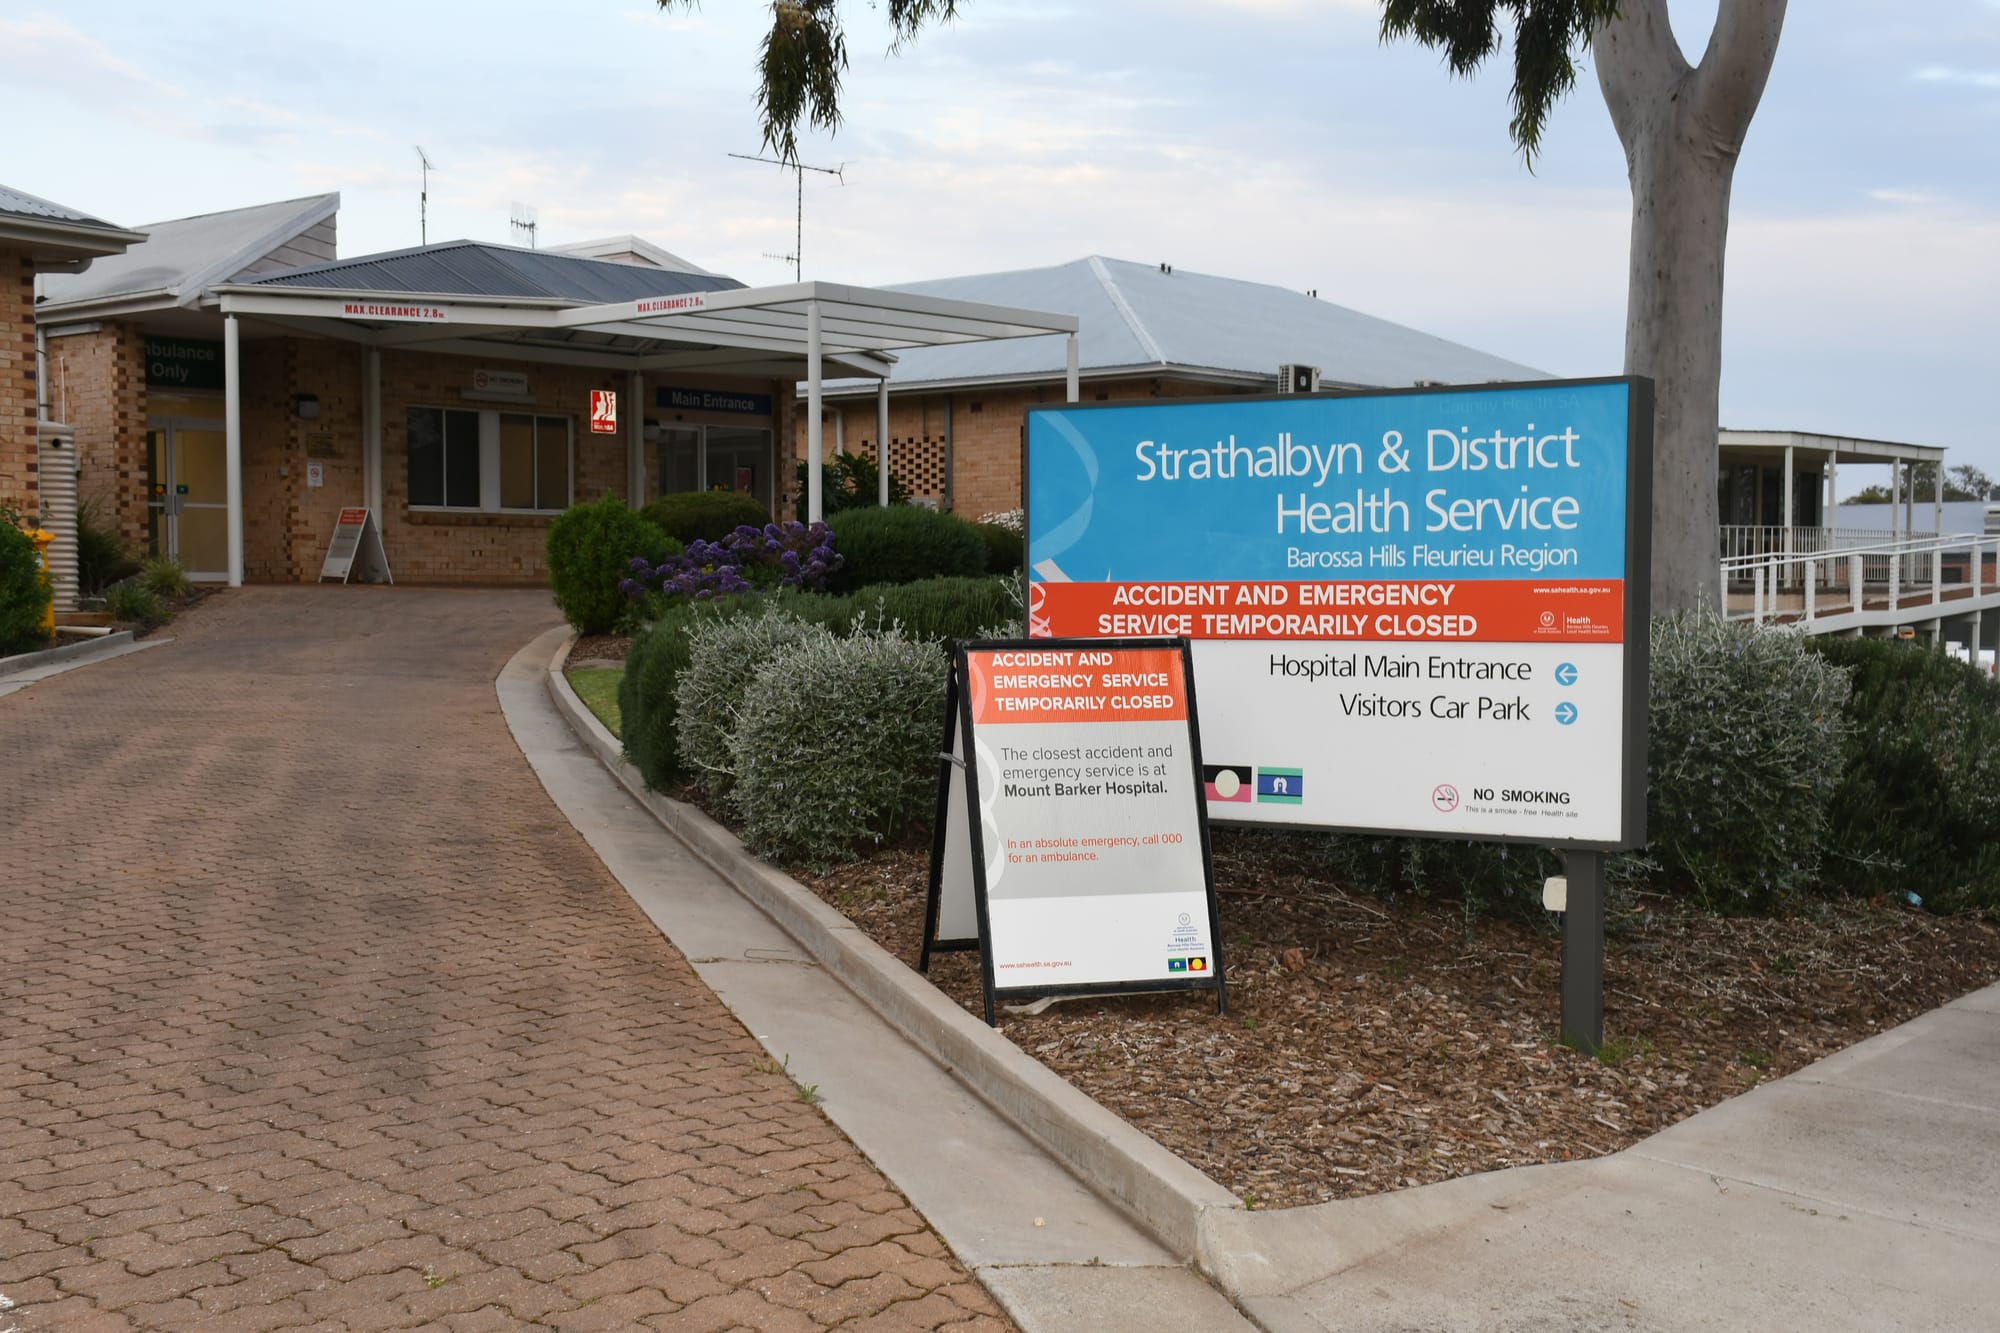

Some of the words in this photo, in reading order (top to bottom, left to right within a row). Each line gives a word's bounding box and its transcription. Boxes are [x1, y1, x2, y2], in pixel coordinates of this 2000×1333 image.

[152, 362, 189, 382] Only
[672, 391, 701, 406] Main
[703, 394, 755, 410] Entrance
[1135, 433, 1362, 488] Strathalbyn
[1377, 430, 1411, 473] &
[1427, 423, 1580, 472] District
[1277, 488, 1409, 534] Health
[1425, 485, 1580, 532] Service
[1287, 547, 1362, 568] Barossa
[1369, 546, 1406, 567] Hills
[1412, 544, 1494, 567] Fleurieu
[1501, 543, 1578, 572] Region
[1112, 585, 1230, 606] ACCIDENT
[1234, 585, 1289, 606] AND
[1299, 584, 1456, 606] EMERGENCY
[1098, 613, 1192, 635] SERVICE
[1201, 614, 1369, 636] TEMPORARILY
[1374, 614, 1478, 637] CLOSED
[1566, 616, 1591, 625] Health
[991, 653, 1074, 667] ACCIDENT
[1078, 652, 1113, 666] AND
[1270, 654, 1356, 683] Hospital
[1364, 655, 1420, 678] Main
[1428, 656, 1532, 680] Entrance
[993, 674, 1093, 689] EMERGENCY
[1102, 673, 1169, 688] SERVICE
[995, 697, 1106, 711] TEMPORARILY
[1111, 695, 1174, 709] CLOSED
[1339, 693, 1422, 718] Visitors
[1430, 696, 1470, 719] Car
[1478, 696, 1531, 720] Park
[1001, 747, 1028, 761] The
[1032, 747, 1081, 760] closest
[1085, 746, 1144, 759] accident
[1147, 744, 1173, 758] and
[1002, 767, 1081, 782] emergency
[1085, 764, 1134, 778] service
[1138, 763, 1150, 776] is
[1153, 763, 1167, 776] at
[1004, 784, 1051, 798] Mount
[1054, 782, 1102, 796] Barker
[1105, 780, 1168, 797] Hospital.
[1473, 788, 1495, 801] NO
[1501, 789, 1570, 805] SMOKING
[1465, 805, 1479, 813] This
[1007, 839, 1016, 849] In
[1019, 840, 1032, 848] an
[1035, 838, 1078, 849] absolute
[1081, 836, 1139, 849] emergency,
[1142, 834, 1159, 845] call
[1161, 833, 1183, 844] 000
[1008, 852, 1022, 863] for
[1025, 854, 1037, 862] an
[1040, 851, 1099, 861] ambulance.
